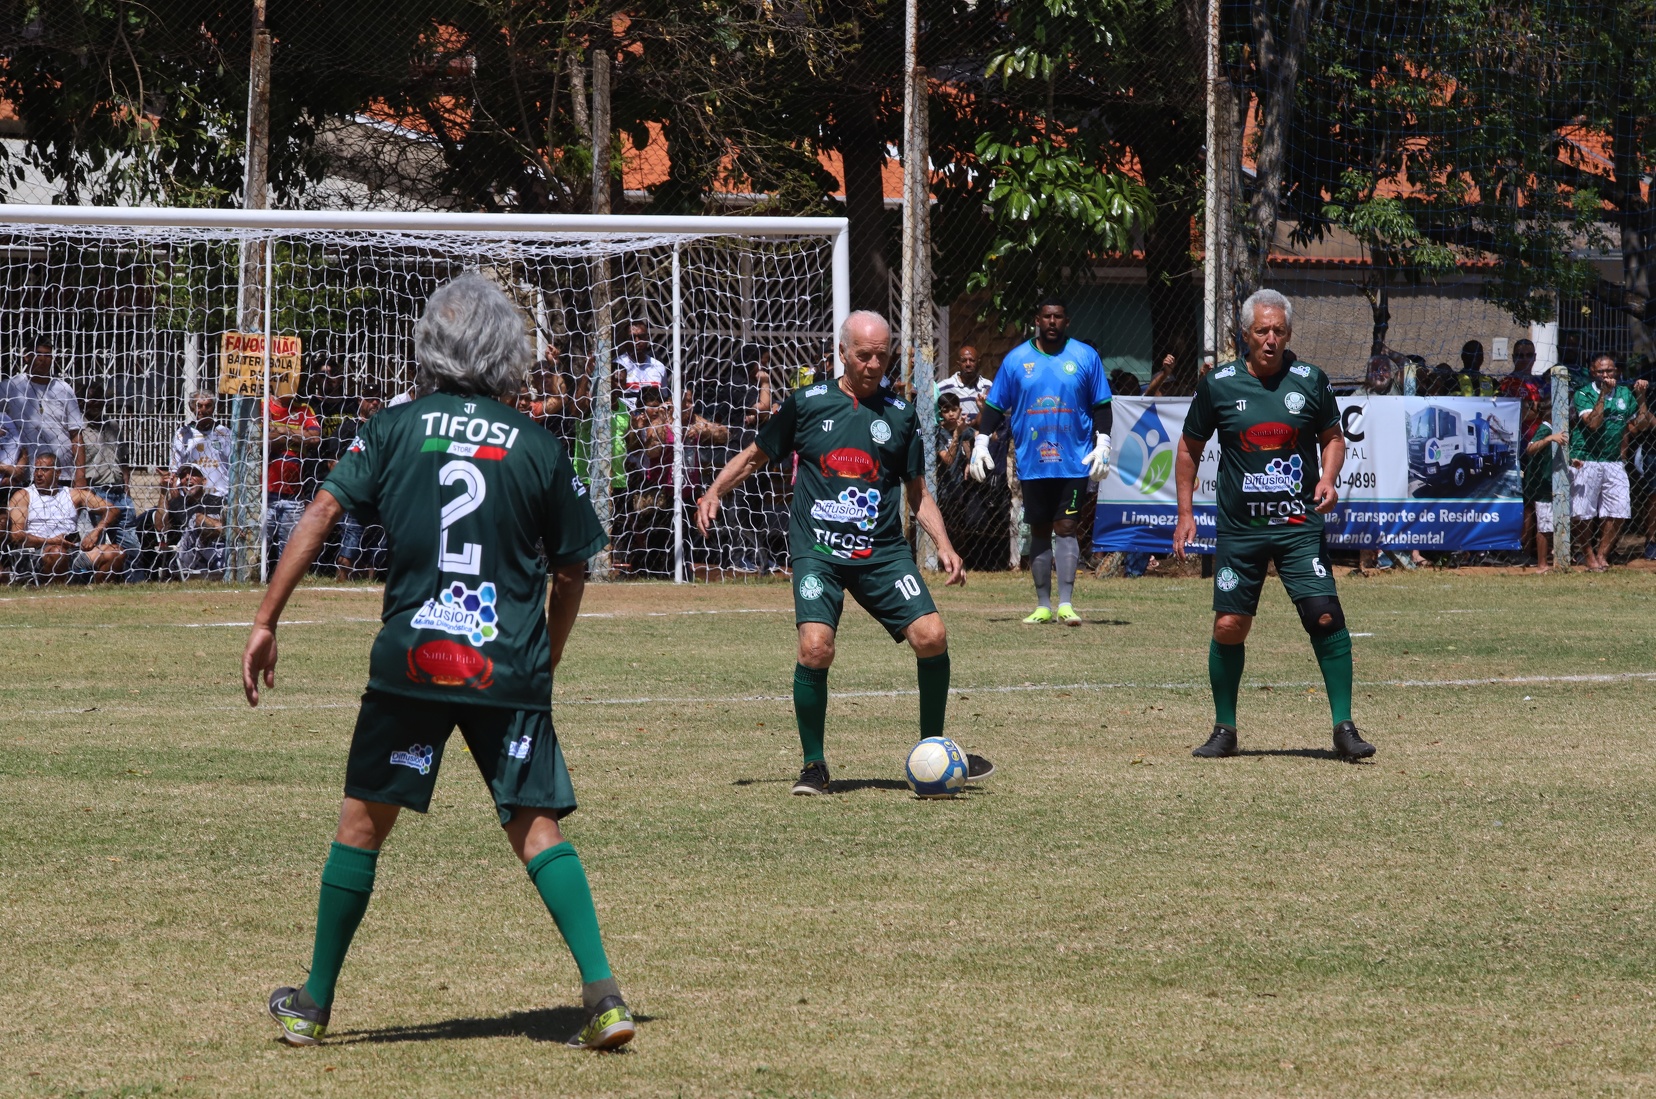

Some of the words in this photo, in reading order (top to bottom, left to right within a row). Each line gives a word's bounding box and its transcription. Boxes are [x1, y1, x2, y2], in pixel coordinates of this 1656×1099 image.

[227, 354, 261, 367] BATER
[269, 357, 293, 369] BOLA
[421, 412, 519, 448] TIFOSI
[452, 445, 472, 453] STORE
[831, 454, 852, 462] Santa
[854, 455, 869, 464] Rita
[1245, 474, 1290, 485] Diffusion
[814, 501, 864, 516] Diffusion
[1247, 500, 1305, 516] TIFOSI
[438, 460, 486, 576] 2
[1344, 508, 1417, 526] Transporte
[1419, 508, 1436, 523] de
[1439, 508, 1500, 523] Resíduos
[813, 528, 874, 550] TIFOSI
[1376, 530, 1444, 545] Ambiental
[1312, 557, 1327, 578] 6
[895, 574, 920, 601] 10
[423, 649, 452, 661] Santa
[456, 652, 476, 664] Rita
